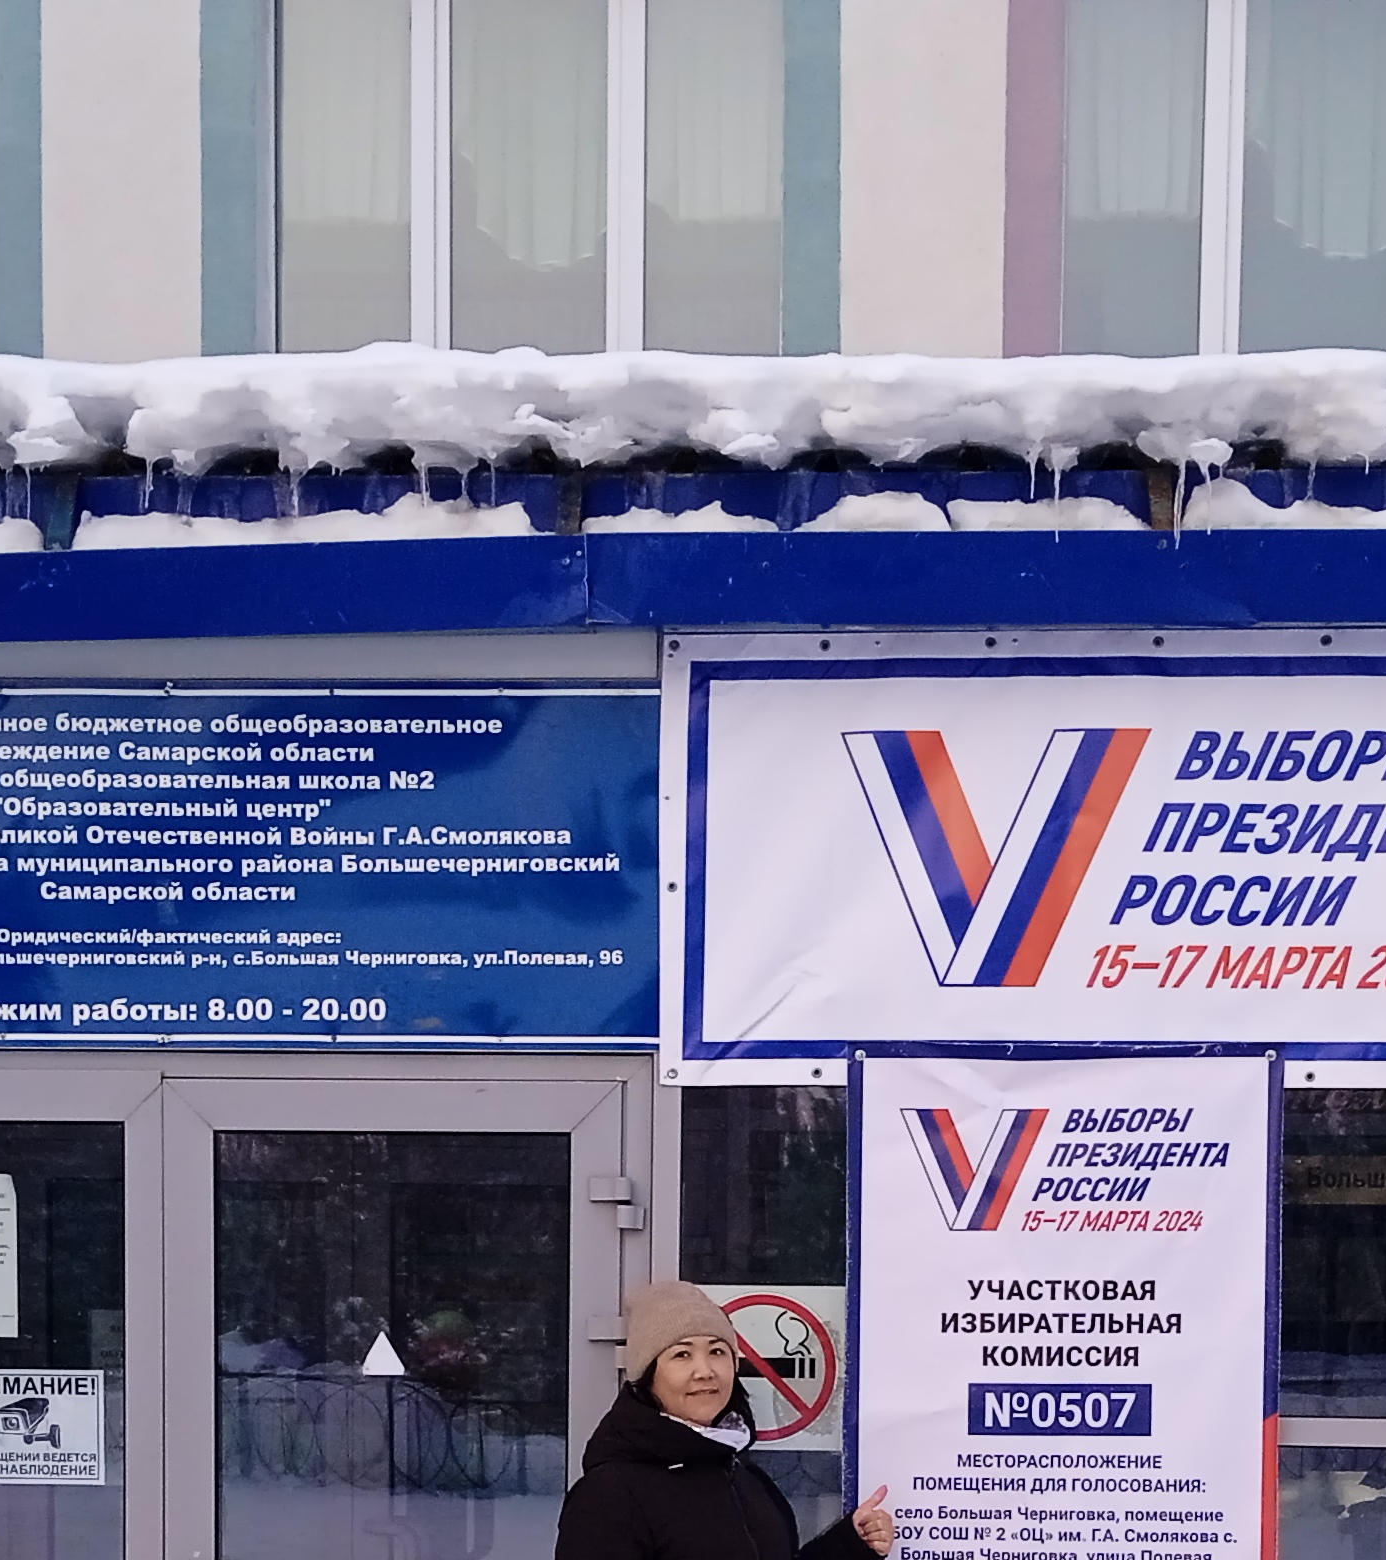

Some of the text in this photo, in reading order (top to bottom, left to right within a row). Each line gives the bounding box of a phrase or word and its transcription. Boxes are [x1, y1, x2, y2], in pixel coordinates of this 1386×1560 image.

[56, 713, 202, 736] бюджетное
[211, 714, 502, 737] общеобразовательное
[119, 742, 261, 765] Самарской
[271, 743, 374, 761] области
[0, 769, 290, 792] общеобразовательная
[299, 776, 380, 789] школа
[390, 771, 434, 789] №2
[247, 799, 331, 822] центр"
[87, 826, 281, 845] Отечественной
[291, 827, 374, 845] Войны
[383, 827, 571, 845] Г.А.Смолякова
[17, 858, 233, 876] муниципального
[242, 854, 333, 877] района
[342, 853, 619, 876] Большечерниговский
[41, 882, 295, 904] Самарской области
[1110, 875, 1357, 927] РОССИИ
[277, 933, 341, 947] адрес:
[192, 954, 227, 968] р-н,
[233, 951, 339, 965] с.Большая
[346, 951, 468, 968] Черниговка,
[474, 950, 594, 968] ул.Полевая,
[600, 950, 623, 965] 96
[1206, 946, 1353, 989] МАРТА
[73, 998, 197, 1026] работы:
[208, 999, 273, 1020] 8.00
[303, 998, 386, 1021] 20.00
[1062, 1108, 1194, 1133] ВЫБОРЫ
[1047, 1143, 1230, 1171] ПРЕЗИДЕНТА
[1032, 1177, 1151, 1202] РОССИИ
[1079, 1211, 1150, 1232] МАРТА
[1153, 1211, 1203, 1232] 2024
[968, 1280, 1155, 1301] УЧАСТКОВАЯ
[941, 1313, 1181, 1334] ИЗБИРАТЕЛЬНАЯ
[983, 1346, 1139, 1367] КОМИССИЯ
[985, 1392, 1136, 1428] №0507
[43, 1453, 97, 1462] ВЕДЕТСЯ
[958, 1454, 1162, 1469] МЕСТОРАСПОЛОЖЕНИЕ
[913, 1477, 1206, 1495] ПОМЕЩЕНИЯ ДЛЯ ГОЛОСОВАНИЯ:
[895, 1506, 1224, 1524] село Большая Черниговка, помещение
[893, 1526, 1237, 1544] БОУ СОШ № 2 «ОЦ» им. Г.А. Смолякова с.
[901, 1547, 974, 1560] Большая
